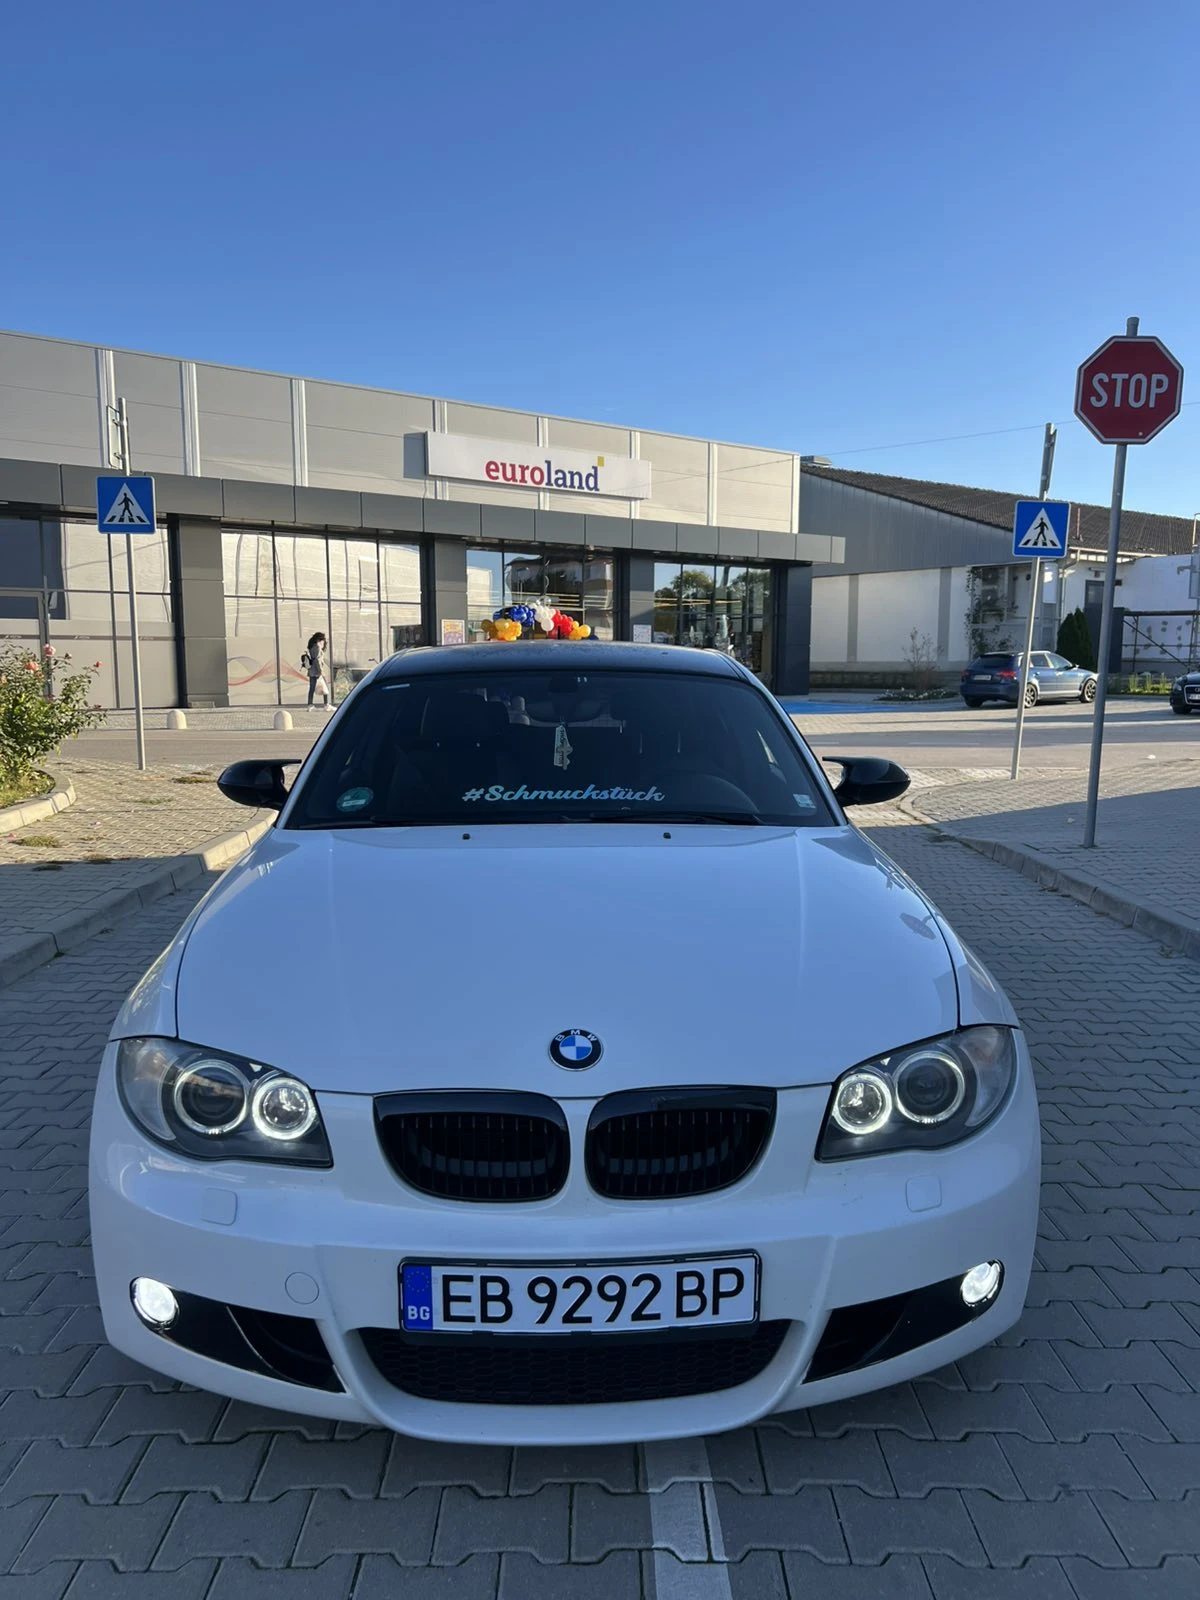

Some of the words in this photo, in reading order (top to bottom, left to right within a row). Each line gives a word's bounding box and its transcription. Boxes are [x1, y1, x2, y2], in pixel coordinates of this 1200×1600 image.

[1090, 372, 1169, 408] STOP
[485, 460, 600, 492] euroland
[462, 784, 666, 802] #Schmuckstück
[555, 1029, 598, 1042] BMW
[442, 1274, 513, 1324] EB
[527, 1273, 662, 1325] 9292
[676, 1267, 745, 1318] BP
[408, 1305, 431, 1321] BG
